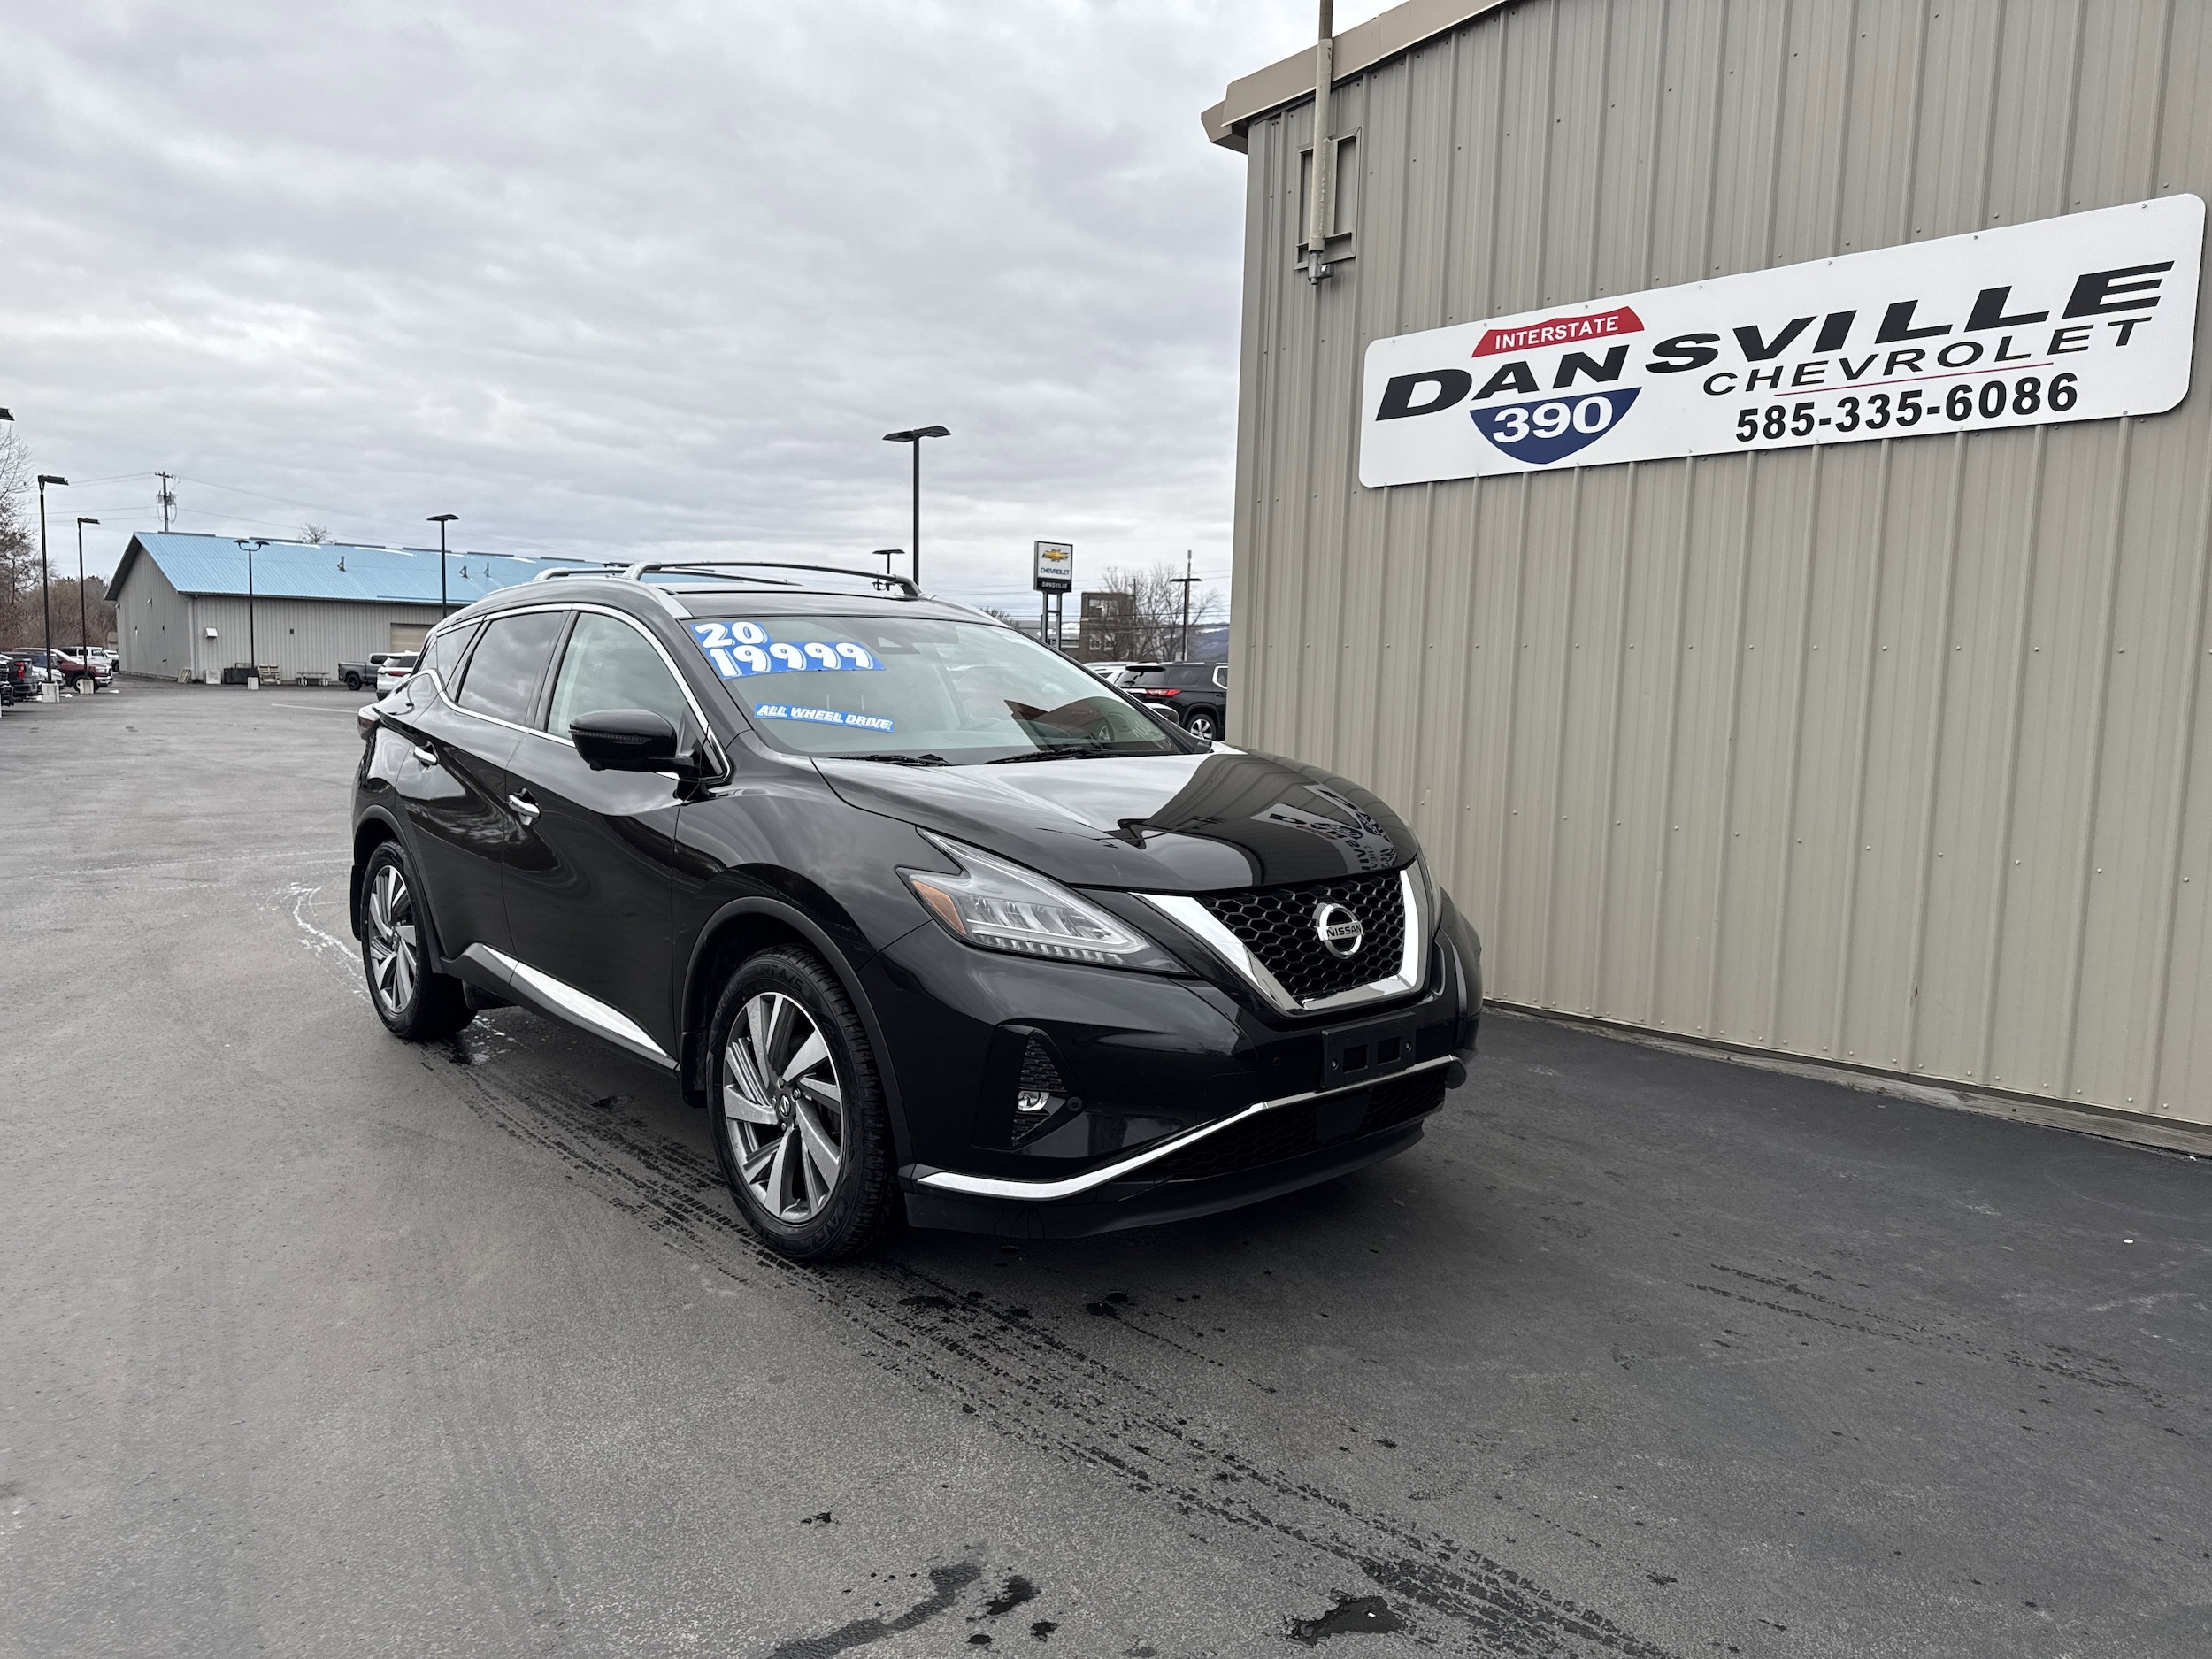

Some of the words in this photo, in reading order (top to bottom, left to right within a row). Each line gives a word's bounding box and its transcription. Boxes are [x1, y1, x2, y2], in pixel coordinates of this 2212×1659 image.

[1375, 260, 2175, 422] DANSVILLE
[1494, 315, 1620, 350] INTERSTATE
[1702, 316, 2154, 396] CHEVROLET
[1491, 398, 1613, 443] 390
[1735, 373, 2078, 442] 585-335-6086
[695, 621, 768, 648] 20
[709, 642, 874, 677] 19999
[756, 704, 788, 718] ALL
[790, 707, 844, 723] WHEEL
[845, 714, 893, 730] DRIVE
[1327, 925, 1362, 937] NISSAN
